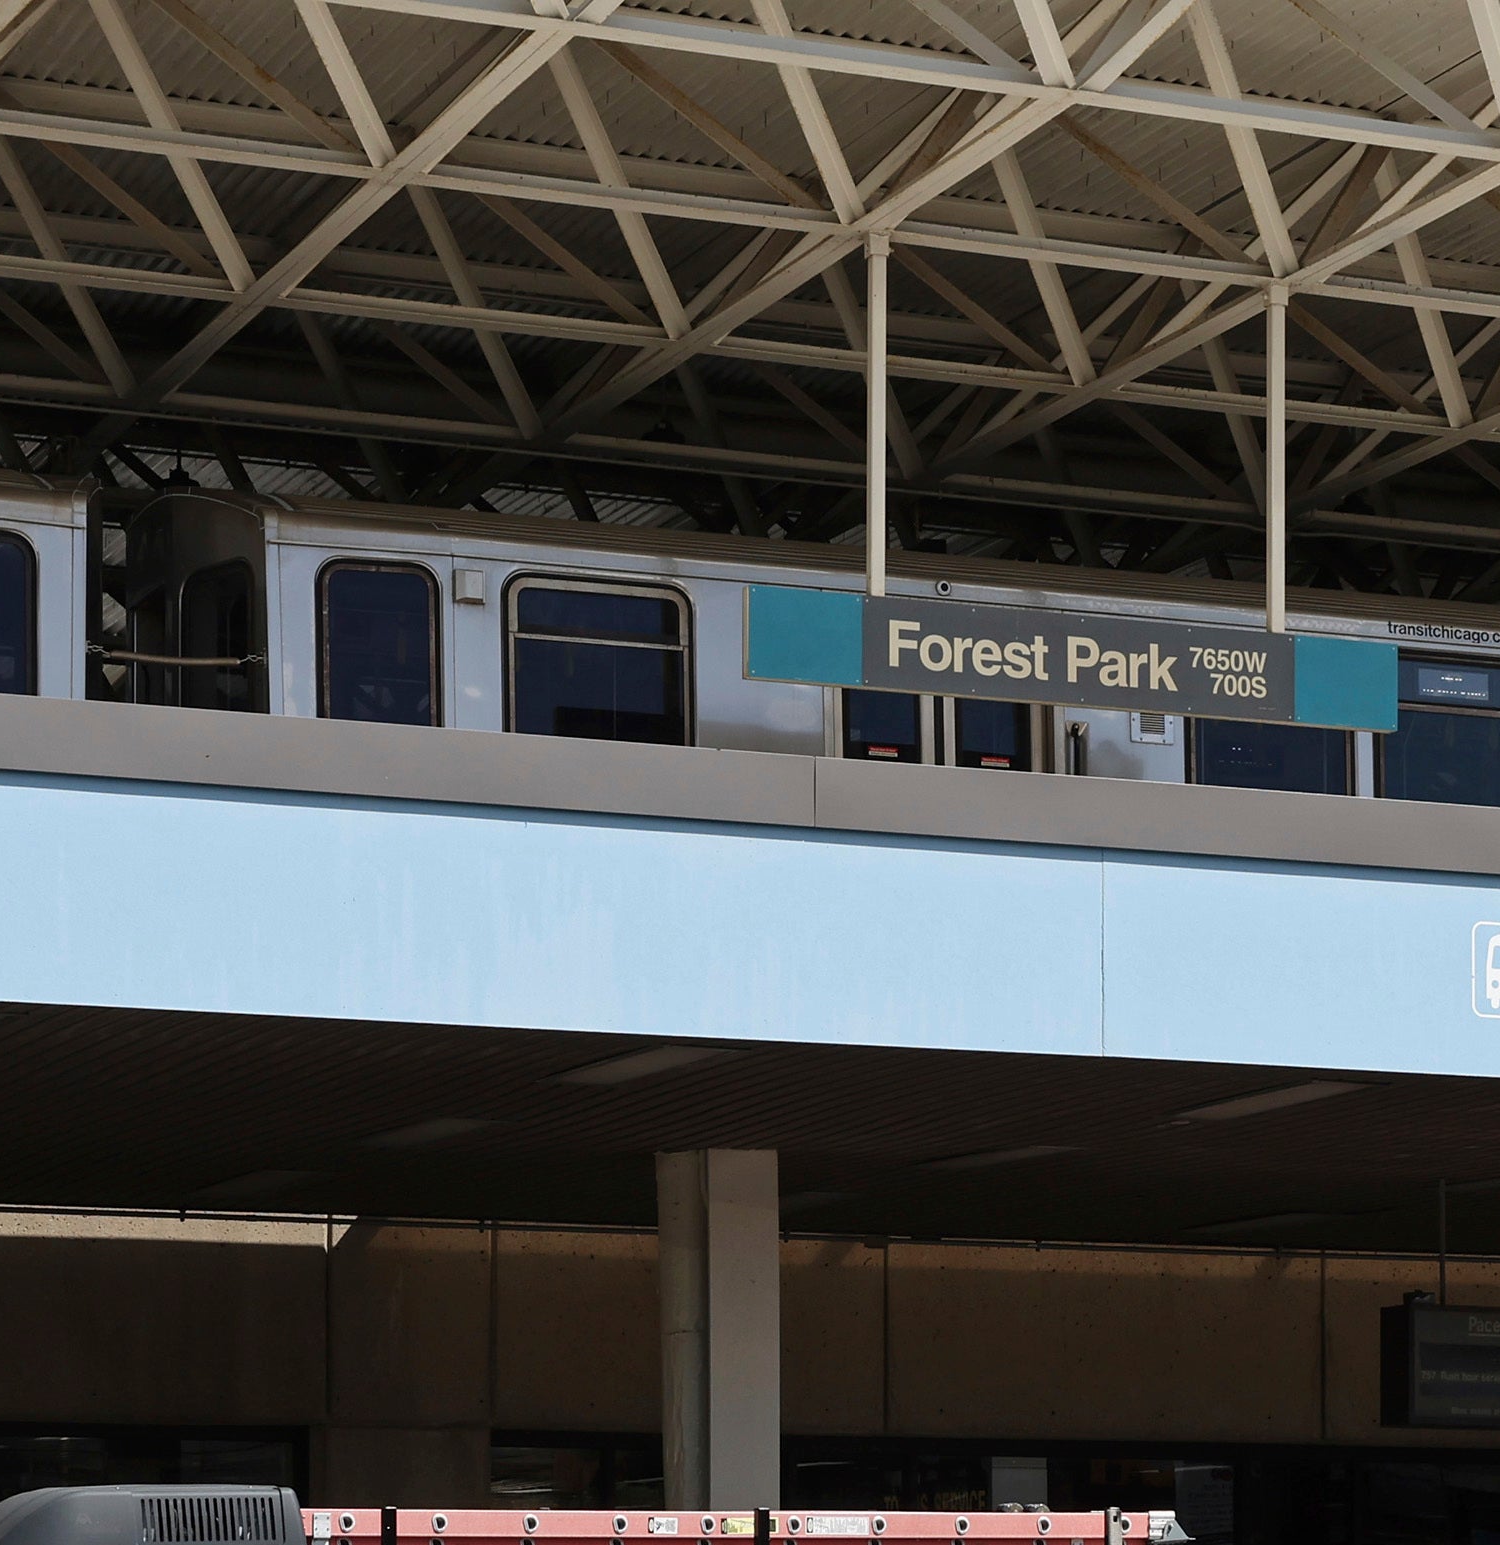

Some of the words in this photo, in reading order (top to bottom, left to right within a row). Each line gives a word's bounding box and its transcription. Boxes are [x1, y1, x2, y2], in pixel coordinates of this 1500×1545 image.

[888, 619, 1049, 680] Forest
[1066, 635, 1178, 692] Park
[1189, 646, 1267, 673] 7650W
[1210, 673, 1267, 699] 700S
[1468, 1316, 1500, 1334] Pace
